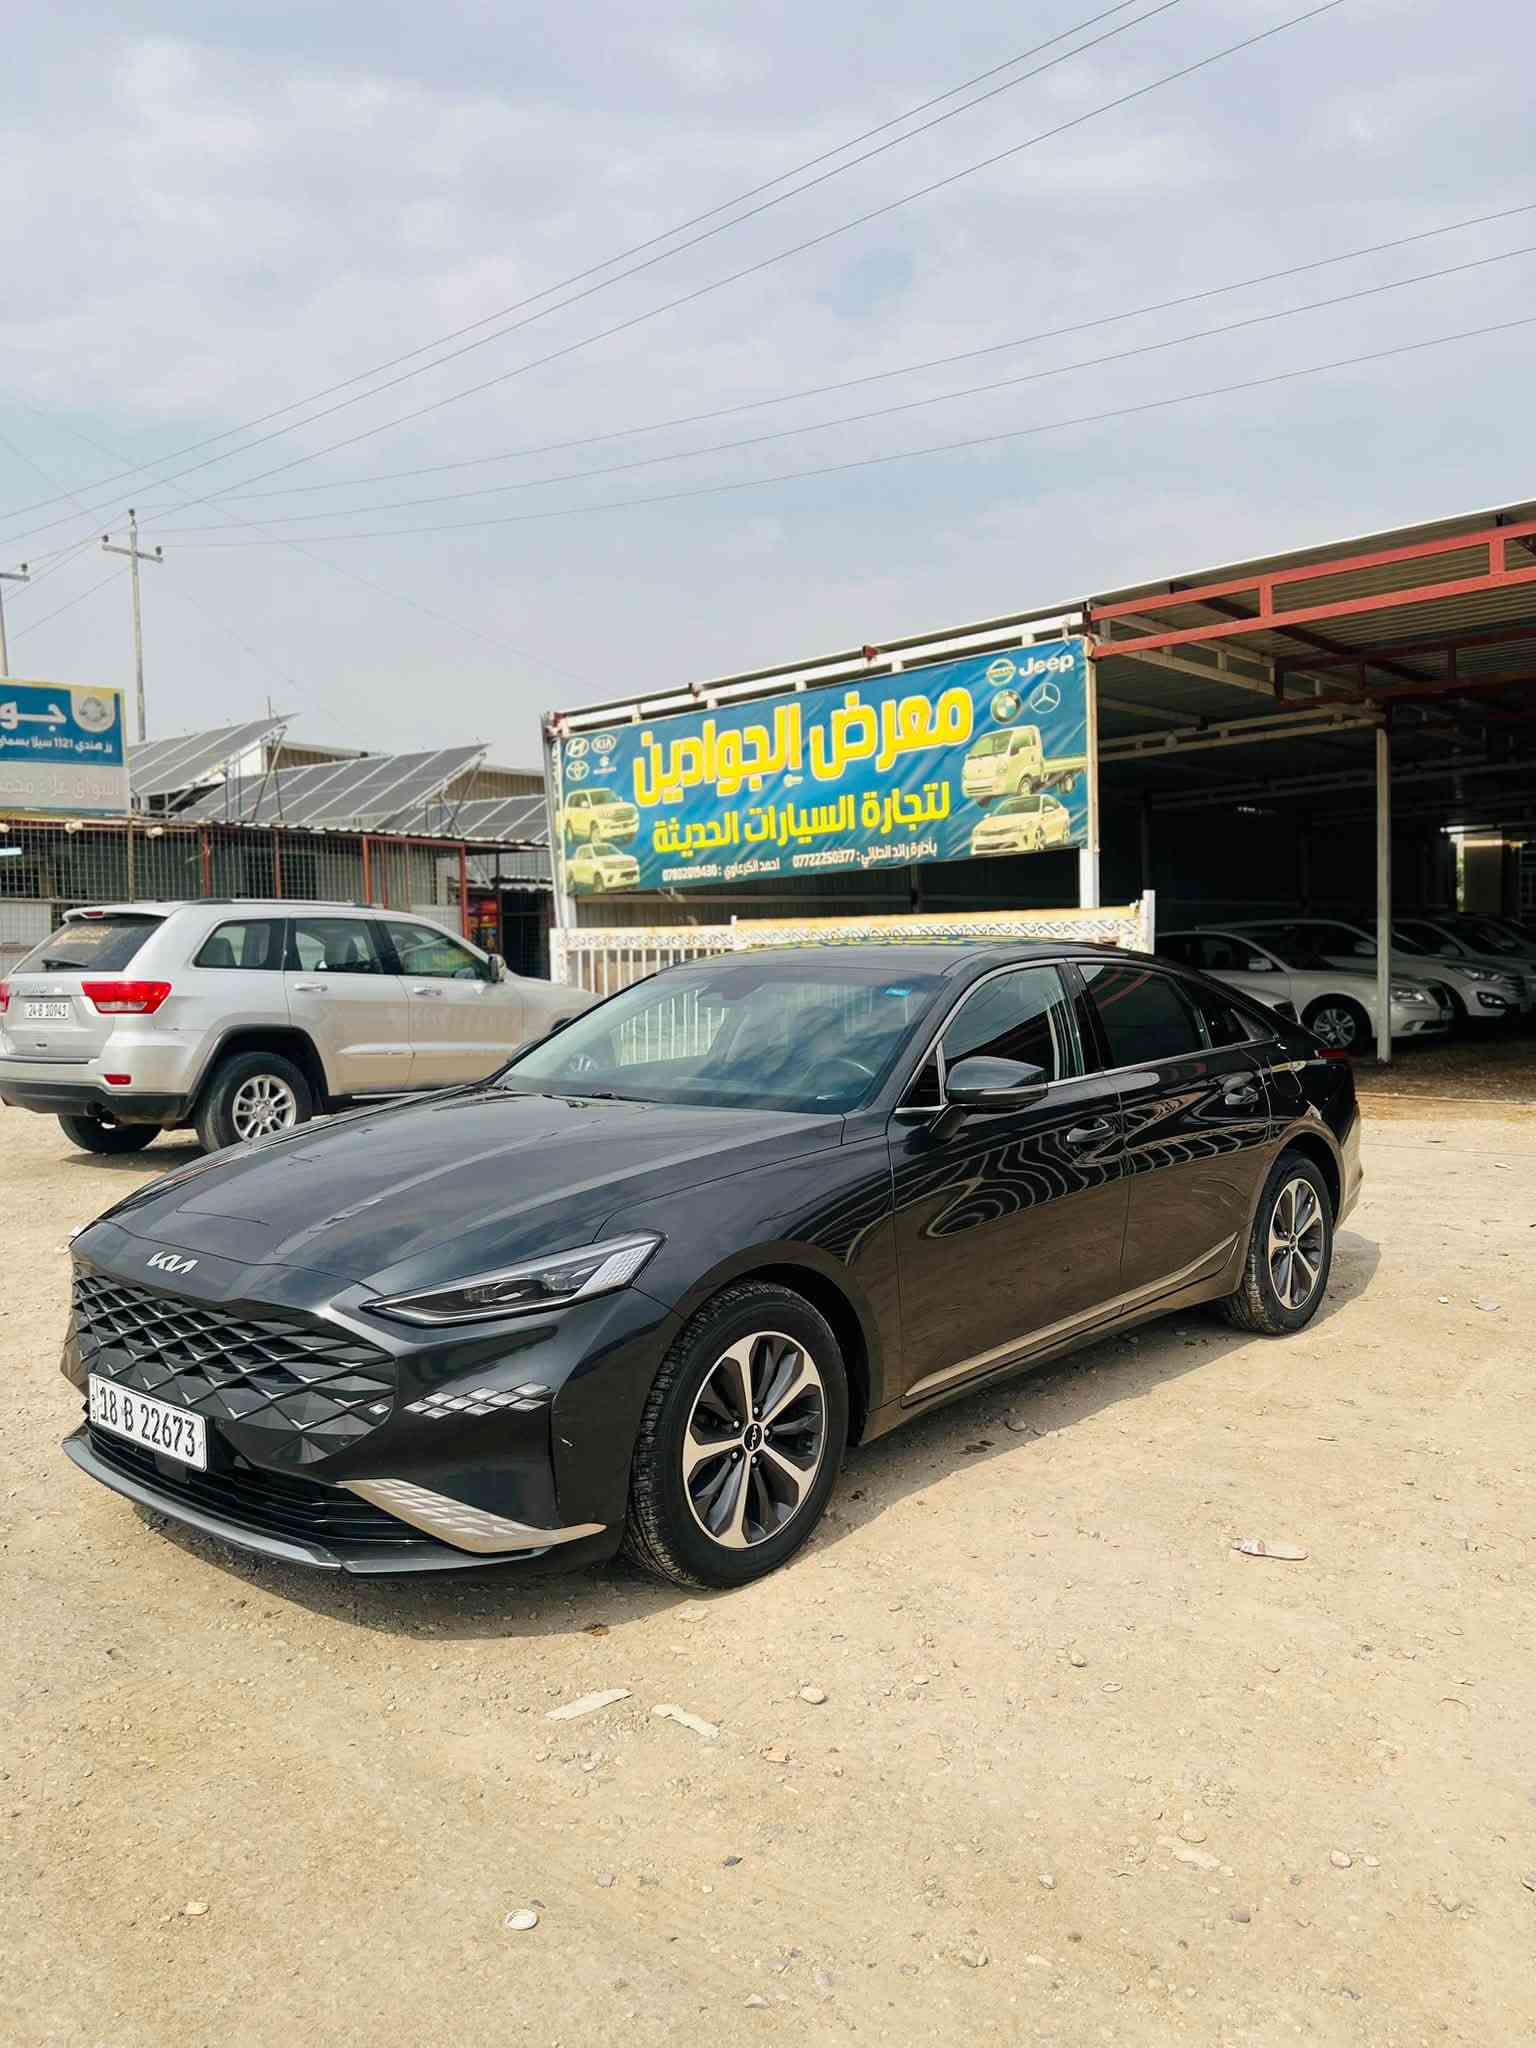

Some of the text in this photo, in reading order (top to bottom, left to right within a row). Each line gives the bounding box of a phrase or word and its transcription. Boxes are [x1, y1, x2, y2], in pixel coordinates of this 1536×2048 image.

[1018, 654, 1074, 677] Jeep
[809, 688, 974, 782] معرض
[653, 781, 950, 858] لتجارة السيارات الحديثة
[99, 1385, 118, 1425] 18
[123, 1396, 134, 1433] B
[140, 1403, 195, 1458] 22673
